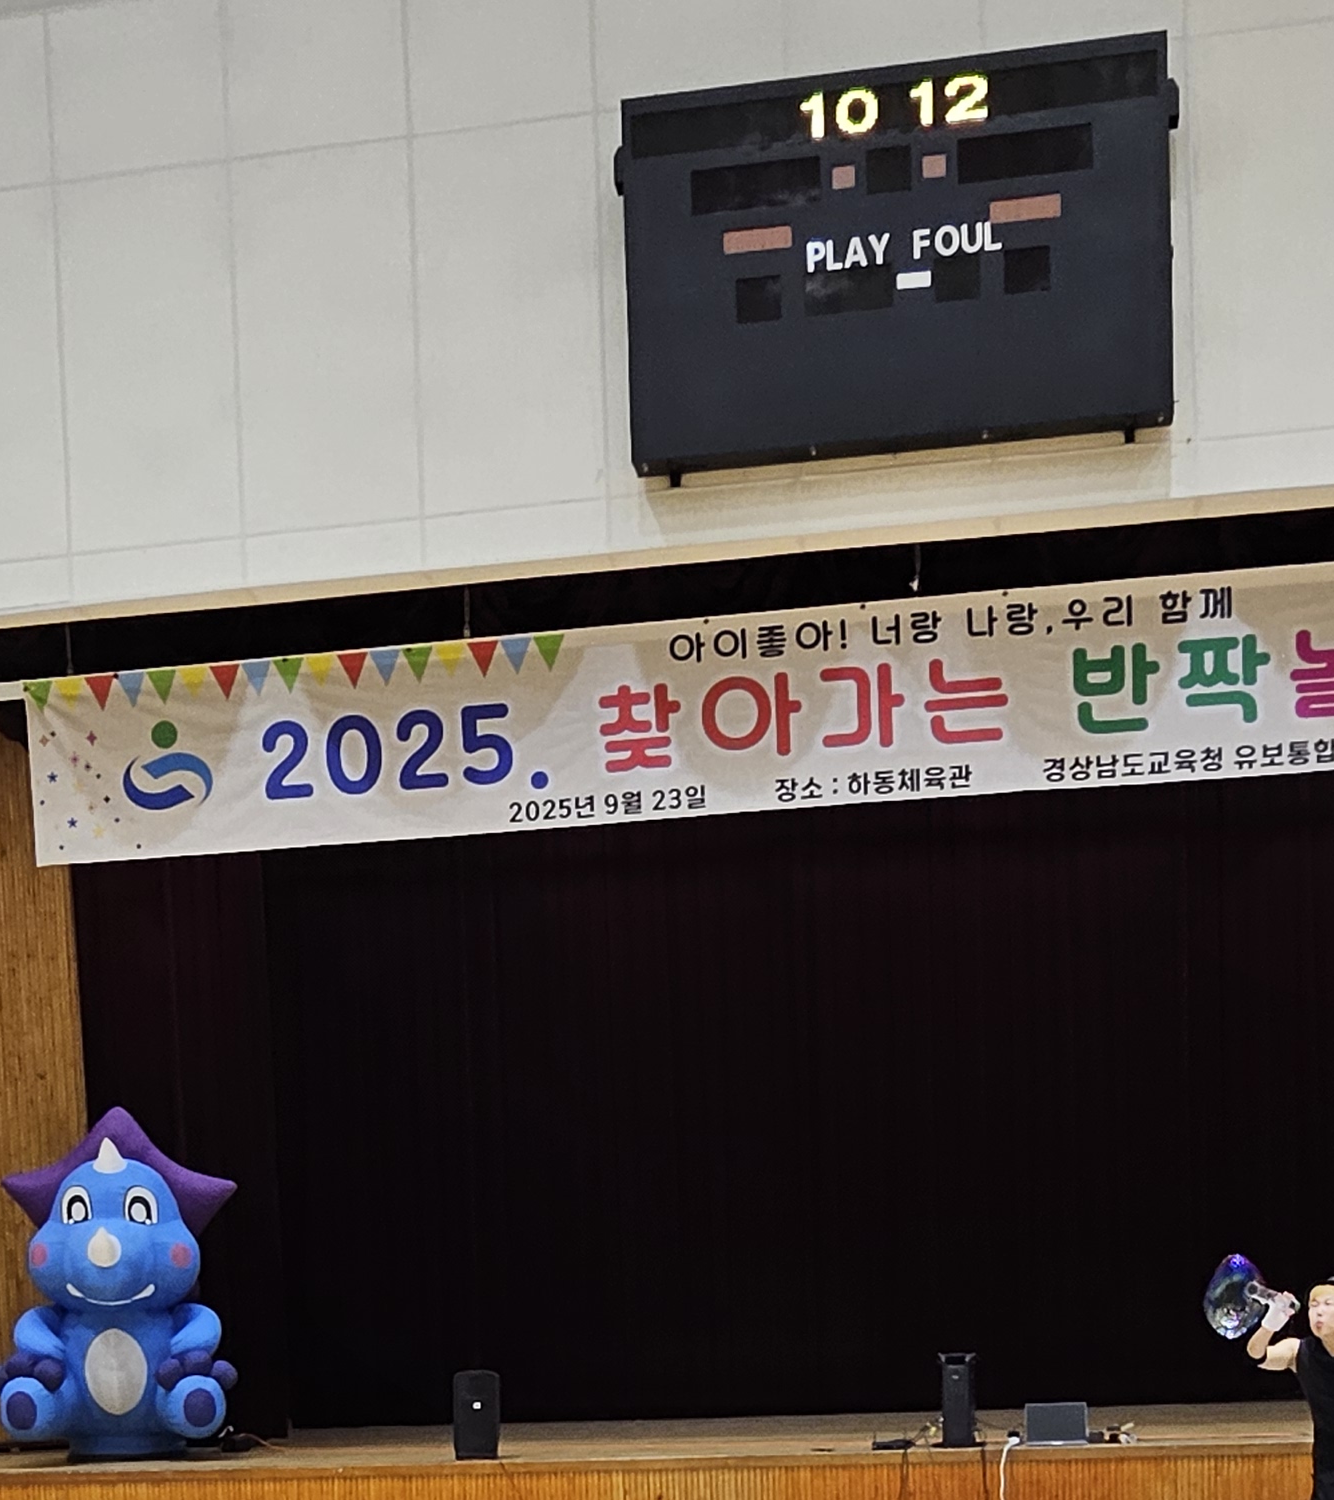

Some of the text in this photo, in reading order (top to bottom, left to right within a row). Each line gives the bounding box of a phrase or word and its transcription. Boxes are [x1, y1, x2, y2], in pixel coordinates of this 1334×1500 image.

[799, 72, 990, 140] 10 12
[806, 219, 1003, 273] PLAY FOUL
[669, 621, 850, 663] 아이좋아!
[871, 610, 942, 647] 너랑
[1158, 585, 1235, 625] 함께
[262, 702, 550, 801] 2025.
[598, 658, 1009, 774] 찾아가는
[510, 794, 596, 823] 2025년
[605, 790, 643, 816] 9월
[652, 785, 707, 811] 23일
[775, 777, 823, 802] 장소
[847, 765, 973, 797] 하동체육관
[1043, 747, 1224, 783] 경상남도교육청
